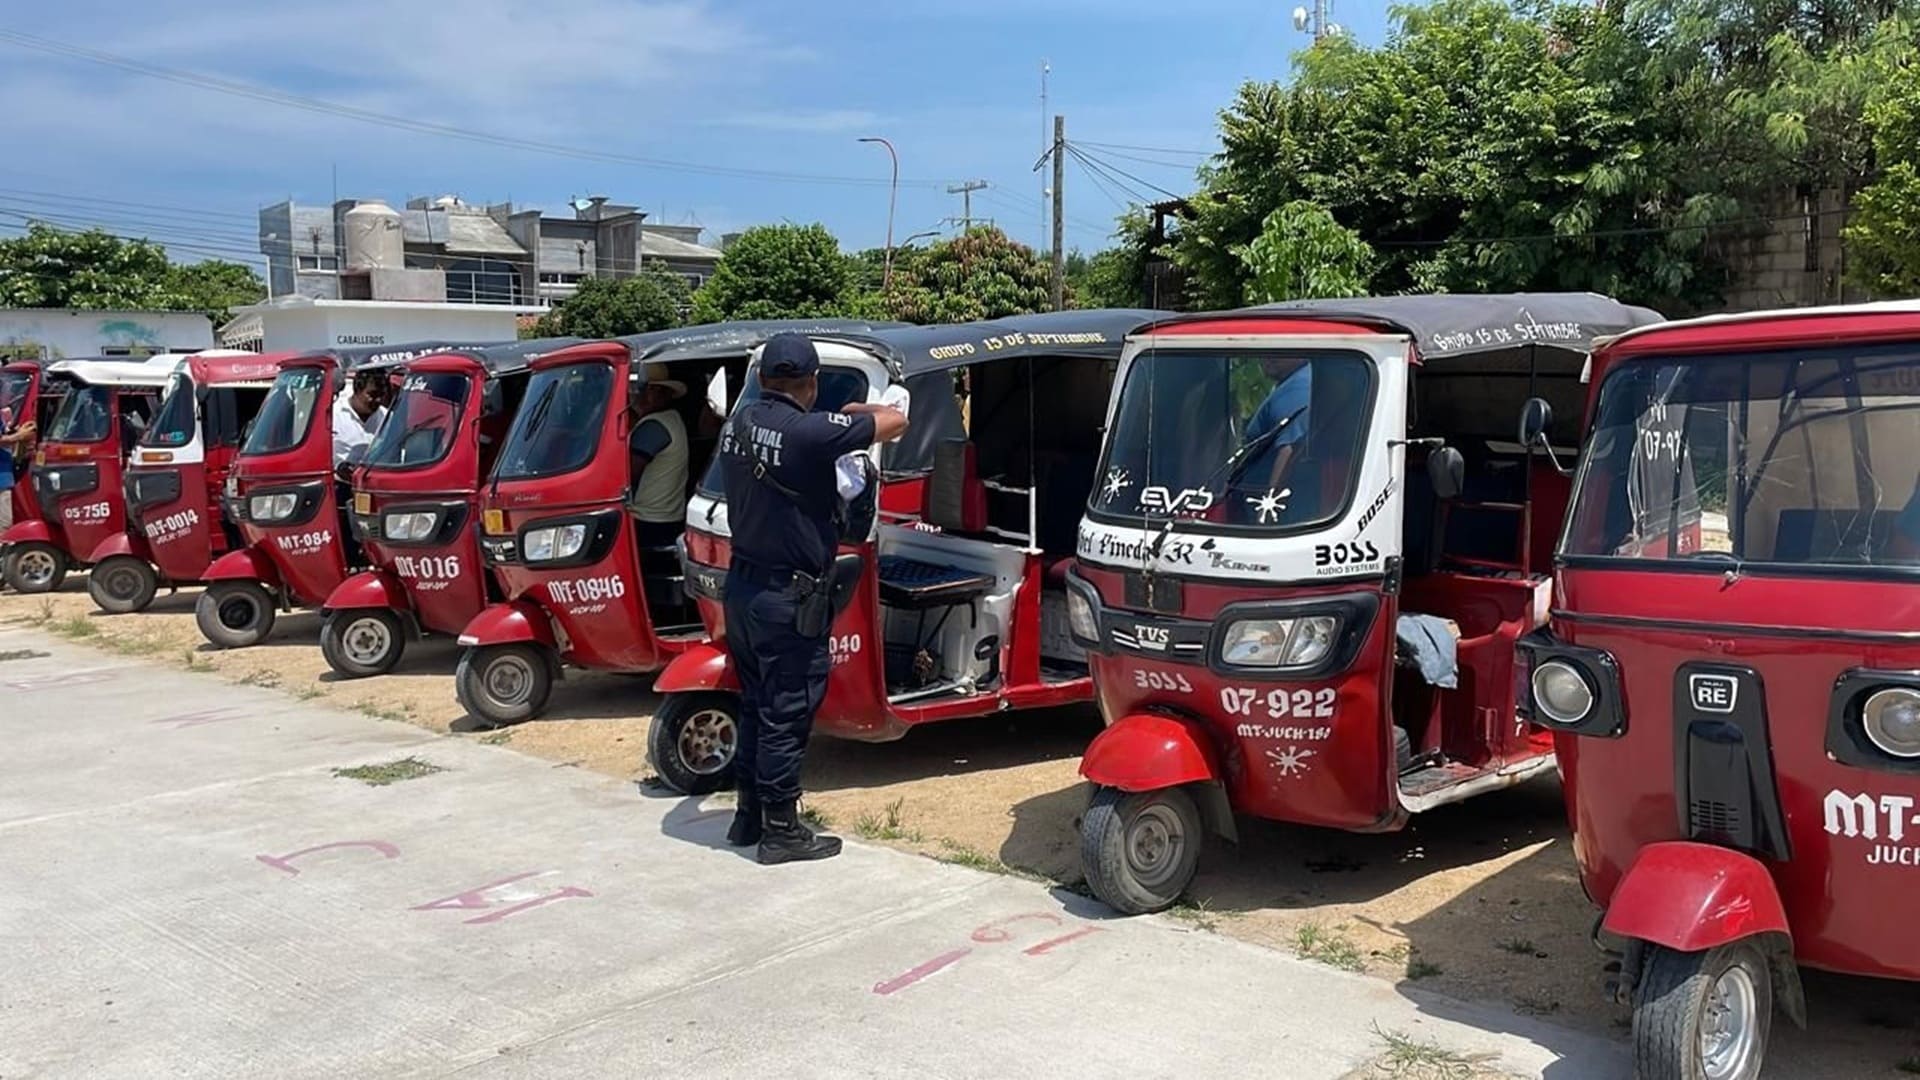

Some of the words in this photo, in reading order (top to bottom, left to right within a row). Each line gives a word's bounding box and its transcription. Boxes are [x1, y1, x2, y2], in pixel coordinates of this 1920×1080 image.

[337, 335, 385, 345] CABALLEROS
[929, 343, 976, 360] GRUPO
[983, 336, 1003, 351] 15
[1006, 332, 1026, 346] DE
[1029, 332, 1107, 344] SEPTIEMBRE
[1476, 328, 1492, 344] 15
[1493, 328, 1513, 342] DE
[65, 502, 110, 519] 05-756
[1354, 478, 1393, 538] BOSE
[278, 530, 332, 550] MT-084
[1315, 541, 1380, 567] BOSS
[395, 555, 461, 580] MT-016
[1316, 566, 1344, 576] AUDIO
[1345, 562, 1380, 574] SYSTEMS
[547, 575, 625, 603] MT-0846
[1134, 624, 1170, 643] TVS
[1133, 669, 1194, 693] BOSS
[1220, 686, 1337, 718] 07-922
[1697, 686, 1728, 705] RE
